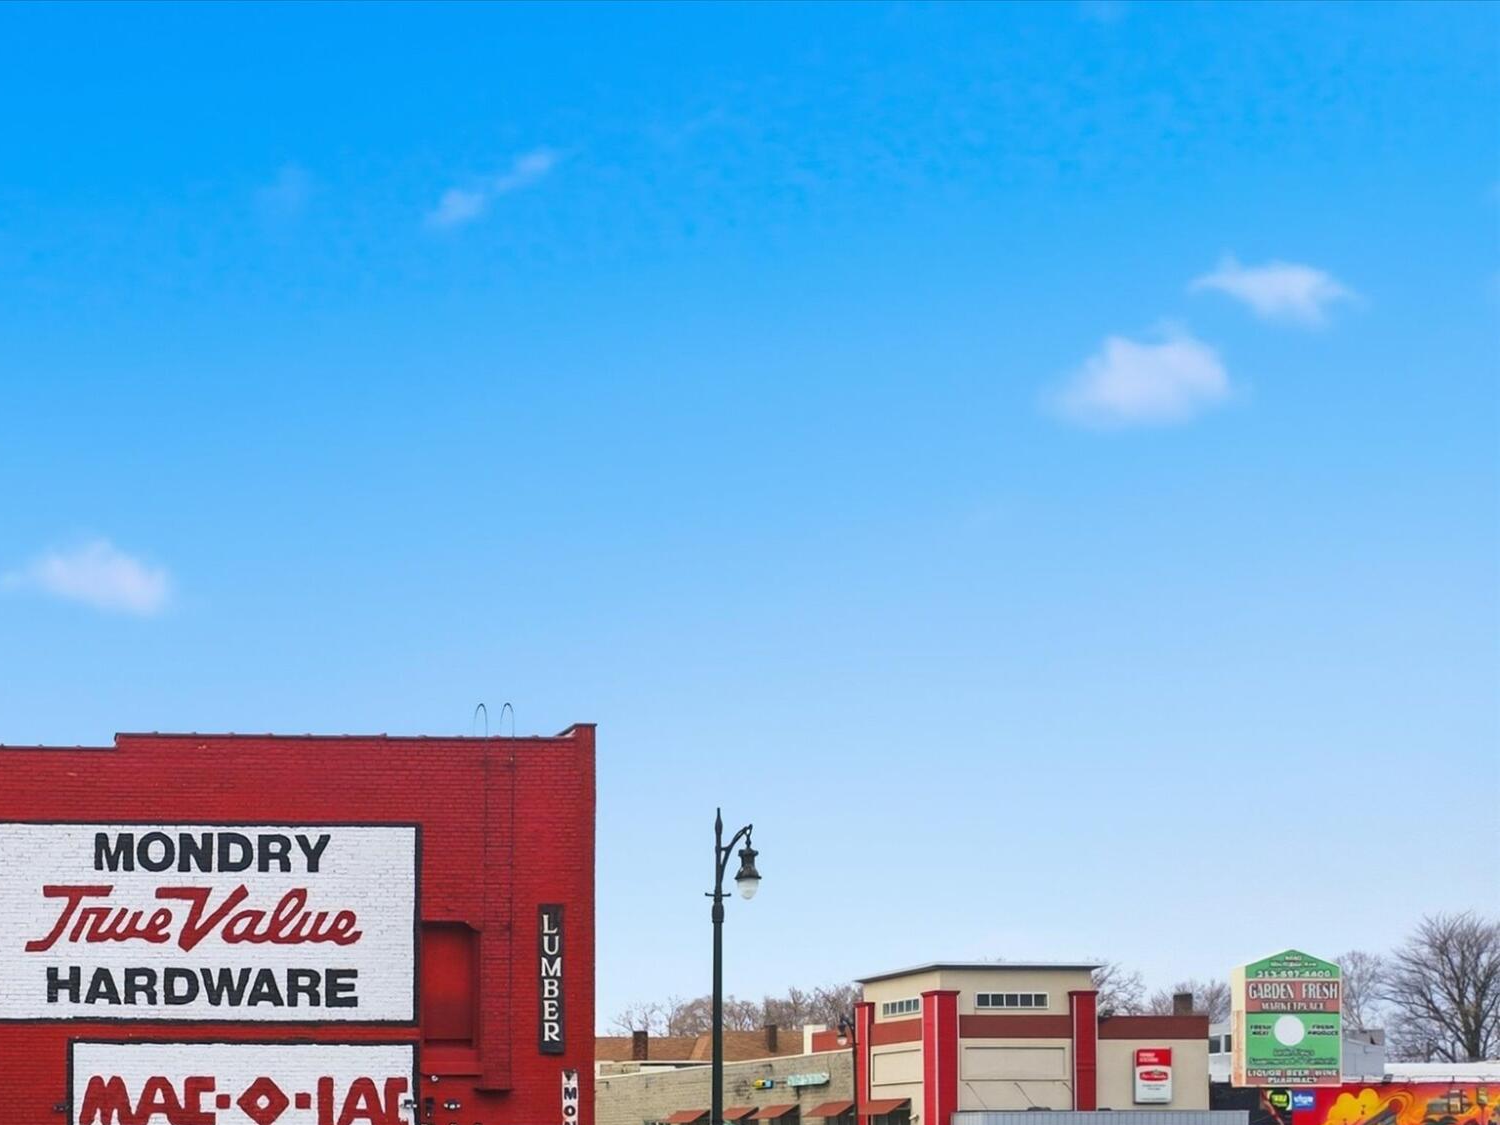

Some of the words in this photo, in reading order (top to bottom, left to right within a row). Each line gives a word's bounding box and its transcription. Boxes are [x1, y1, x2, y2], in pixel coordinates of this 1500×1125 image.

[93, 831, 331, 873] MONDRY
[25, 885, 171, 952] True
[155, 884, 363, 953] Value
[46, 966, 359, 1008] HARDWARE
[541, 913, 563, 1041] LUMBER
[1248, 982, 1294, 999] GARDEN
[1302, 982, 1338, 999] FRESH
[1247, 1069, 1282, 1077] LIQUOR
